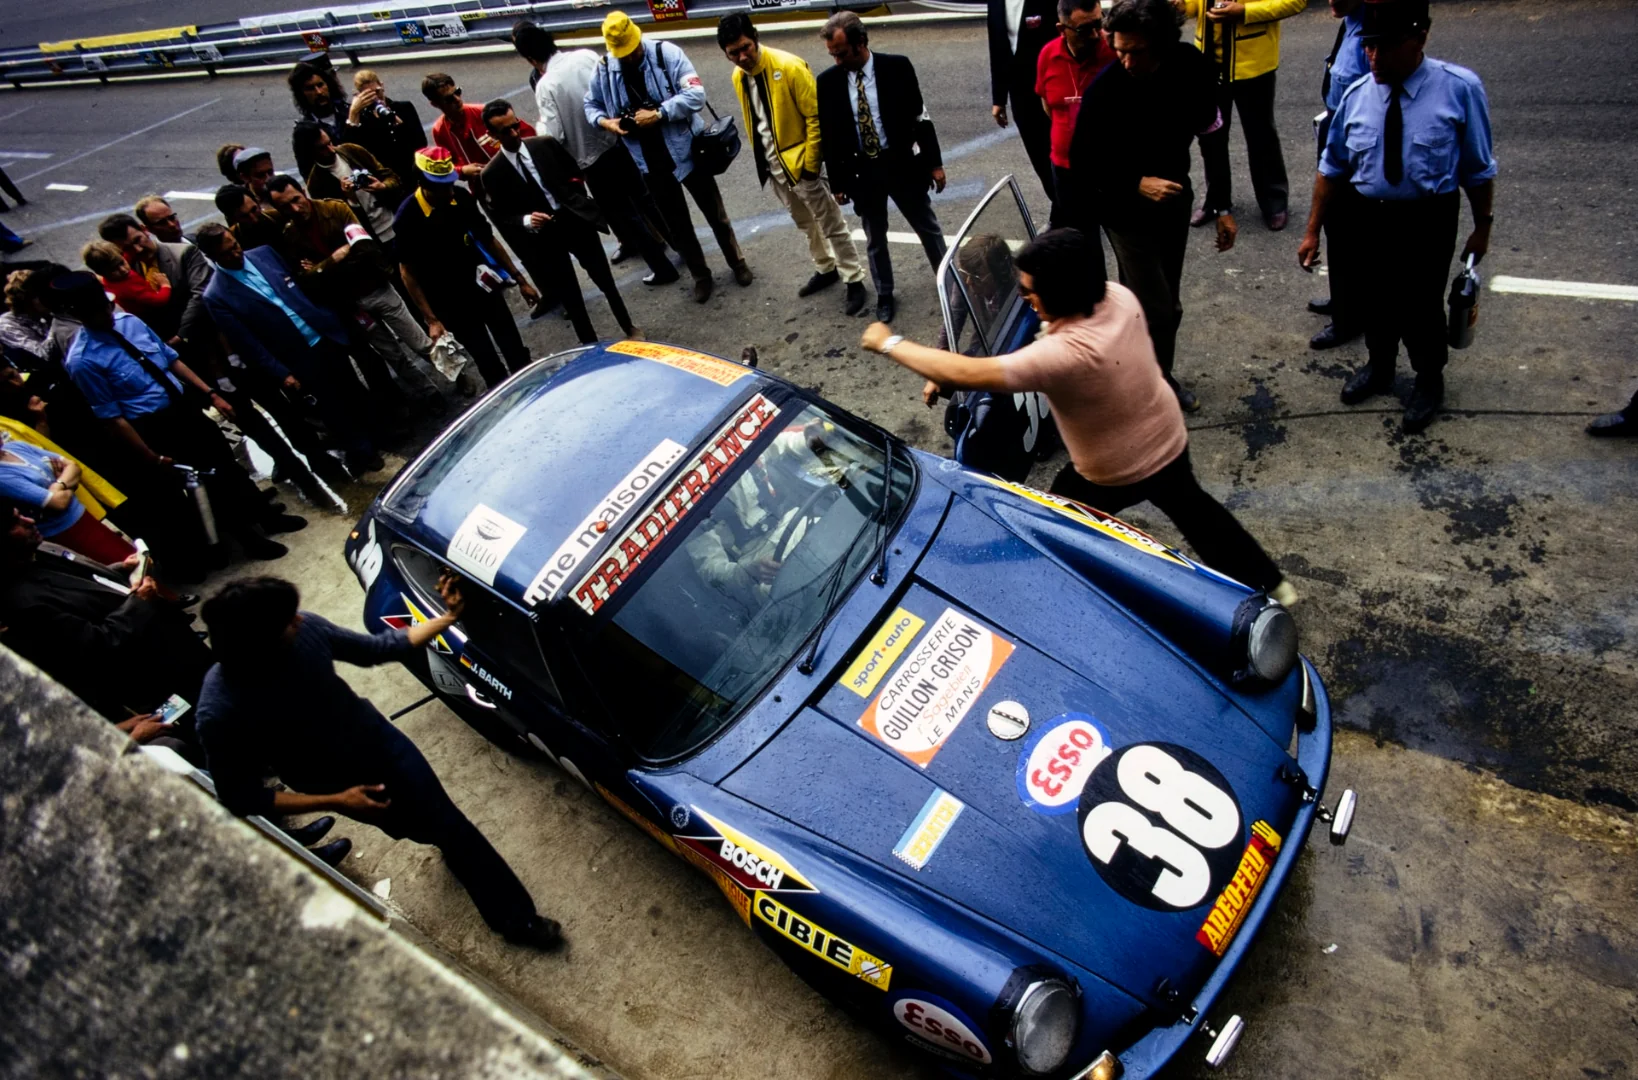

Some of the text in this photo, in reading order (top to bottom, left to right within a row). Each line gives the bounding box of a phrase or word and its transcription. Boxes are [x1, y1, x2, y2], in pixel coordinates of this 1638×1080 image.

[575, 394, 778, 613] TRADIFRANCE
[453, 537, 498, 568] LARIO
[531, 552, 576, 603] une
[470, 663, 512, 700] J.BARTH
[880, 616, 957, 711] CARROSSERIE
[883, 623, 982, 741] GUILLON-GRISON
[927, 677, 981, 746] LE MANS
[1083, 745, 1240, 908] 38
[719, 837, 785, 890] BOSCH
